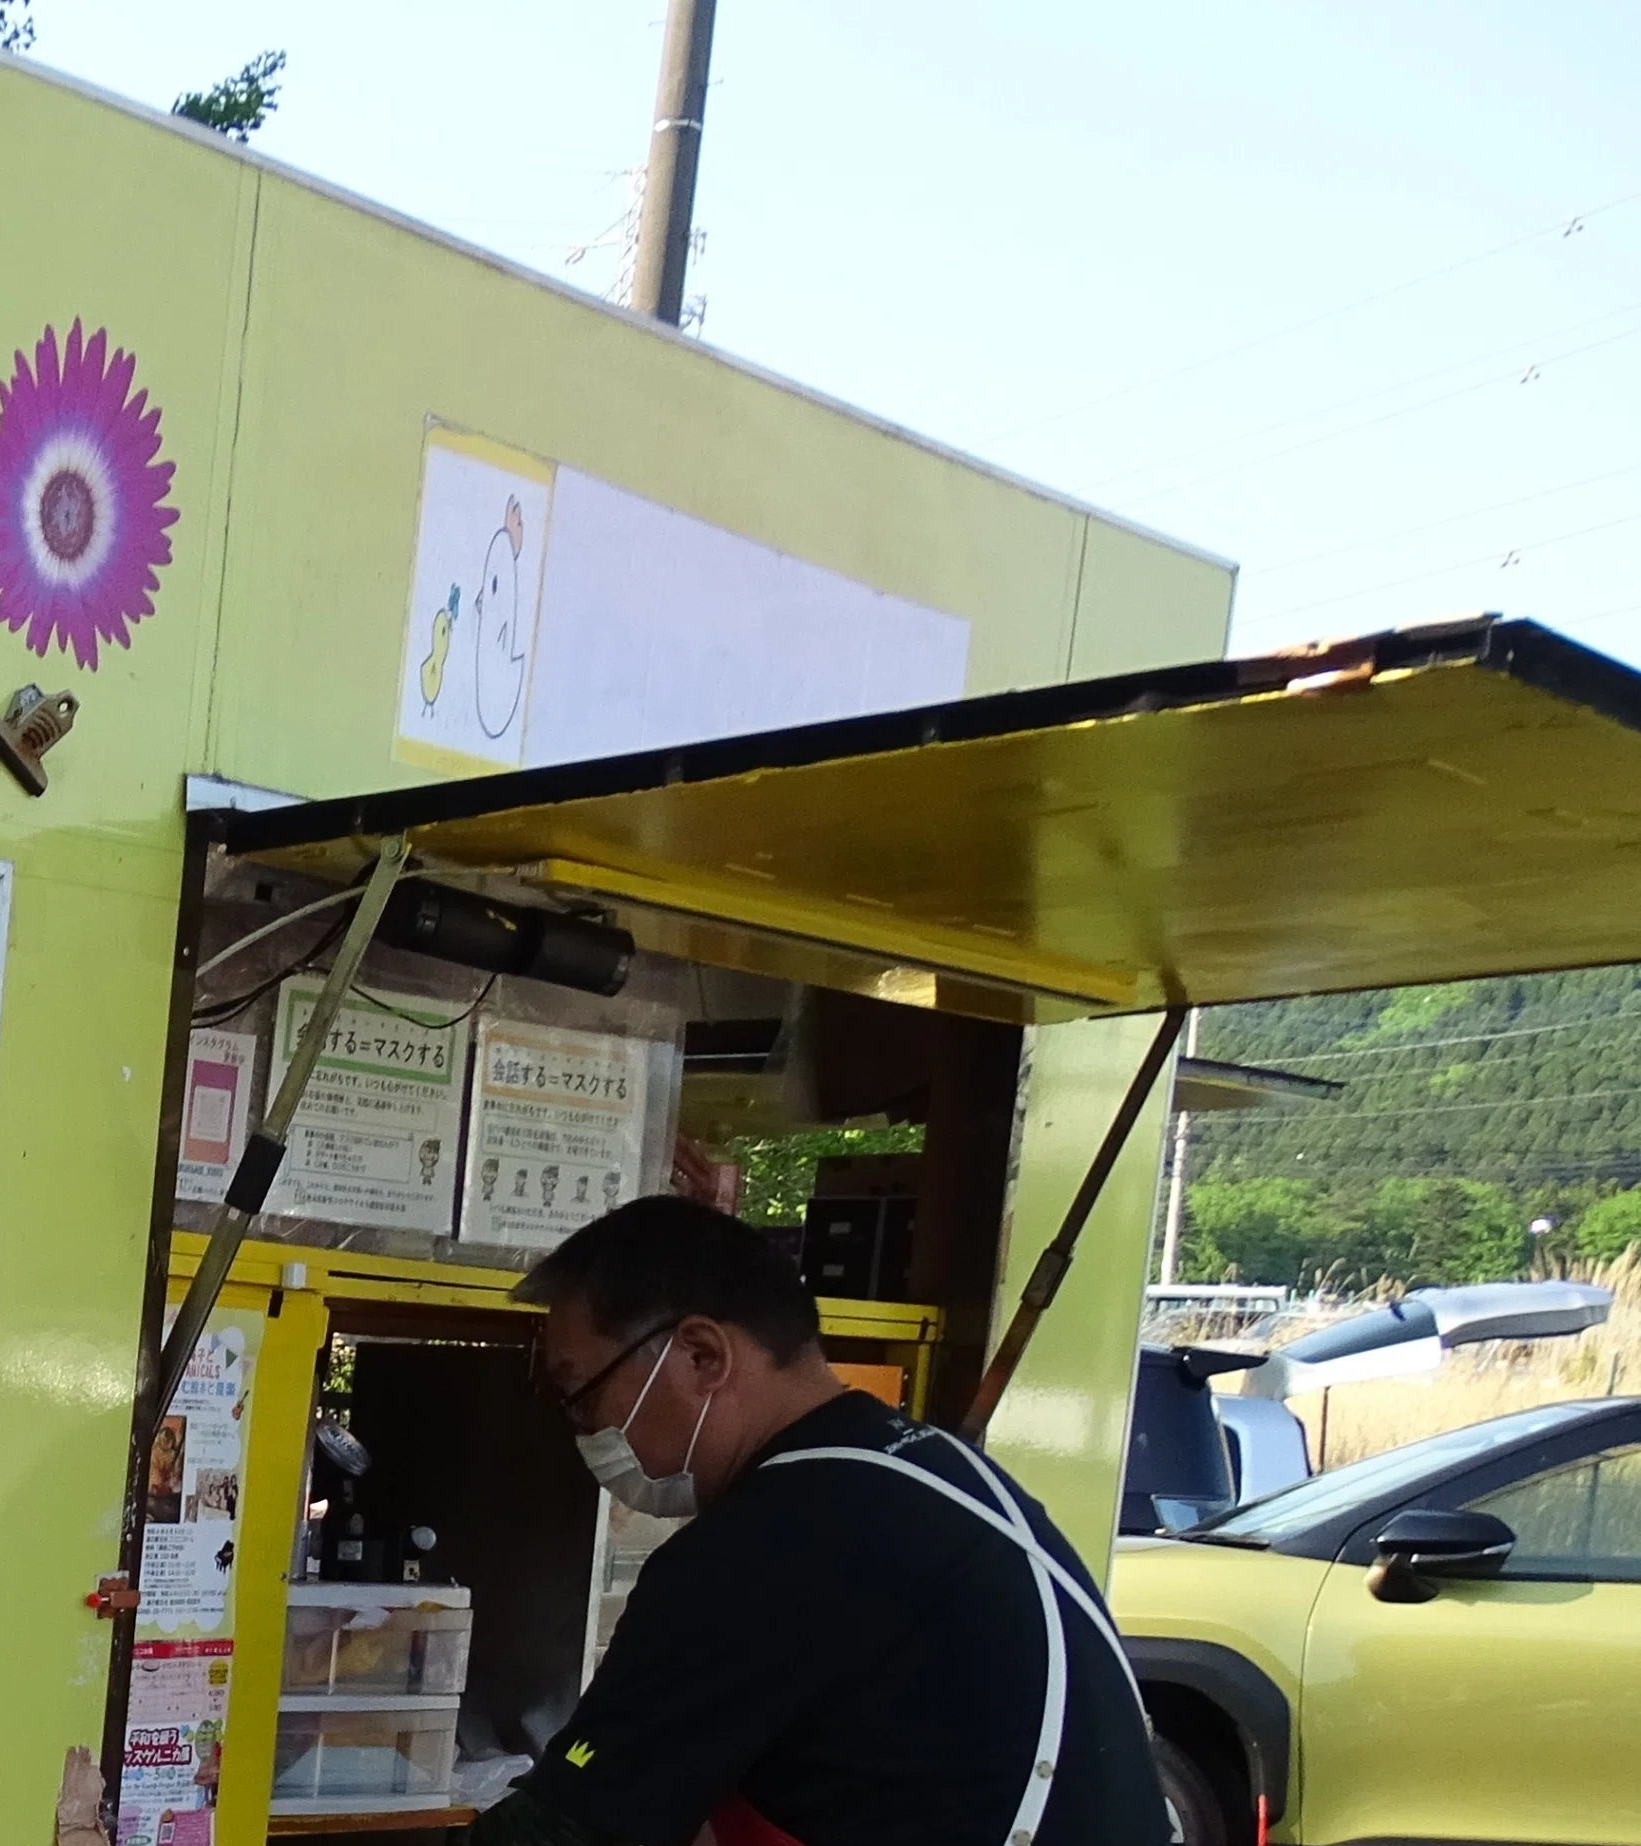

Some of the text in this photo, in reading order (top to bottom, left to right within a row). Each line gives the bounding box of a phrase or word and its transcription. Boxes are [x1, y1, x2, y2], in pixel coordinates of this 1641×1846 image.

[297, 1024, 445, 1069] する=マスクする
